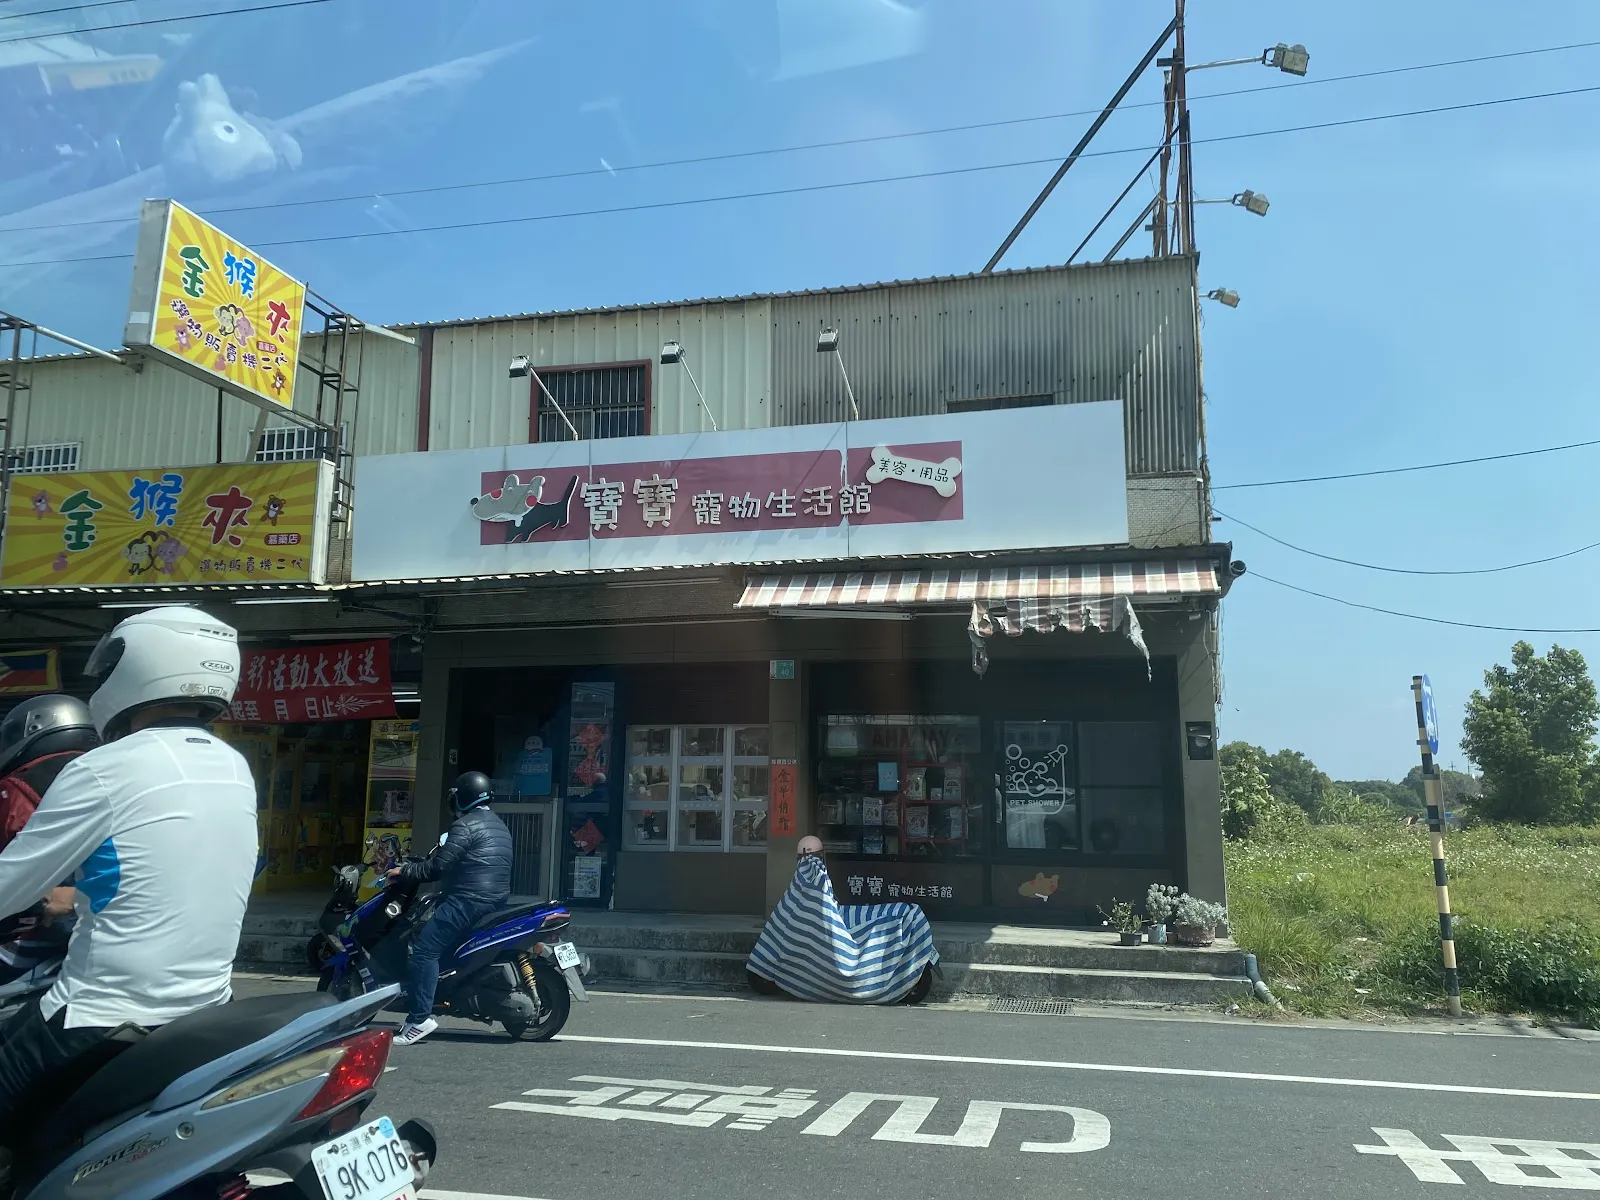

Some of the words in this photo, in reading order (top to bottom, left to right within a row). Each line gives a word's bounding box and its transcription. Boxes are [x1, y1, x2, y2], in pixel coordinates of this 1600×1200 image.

[179, 245, 291, 343] 金猴夾
[59, 473, 253, 552] 金猴夾
[238, 646, 380, 692] 彩活動大放送
[274, 698, 290, 721] 月
[1028, 799, 1060, 807] SHOWER
